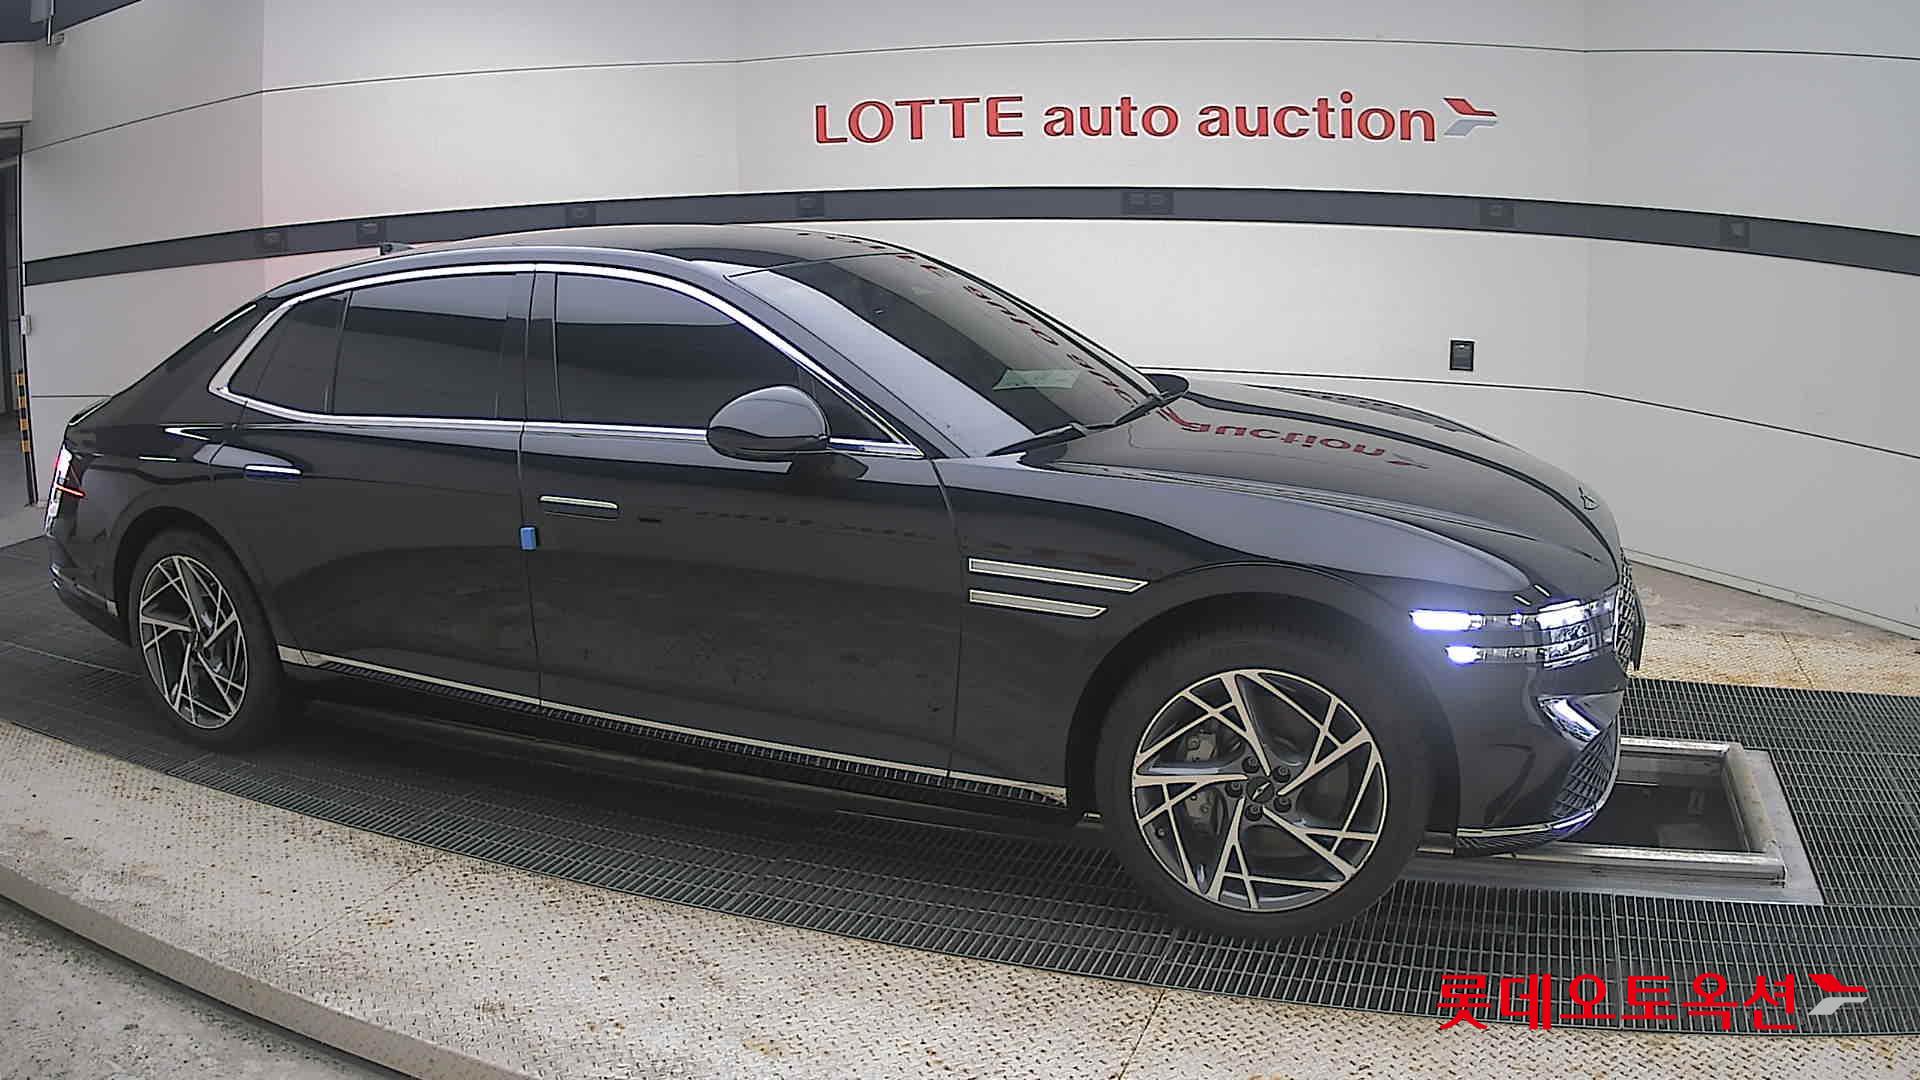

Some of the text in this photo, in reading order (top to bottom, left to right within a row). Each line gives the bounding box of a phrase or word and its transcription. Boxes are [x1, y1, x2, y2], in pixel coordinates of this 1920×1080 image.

[815, 91, 1435, 143] LOTTE auto auction
